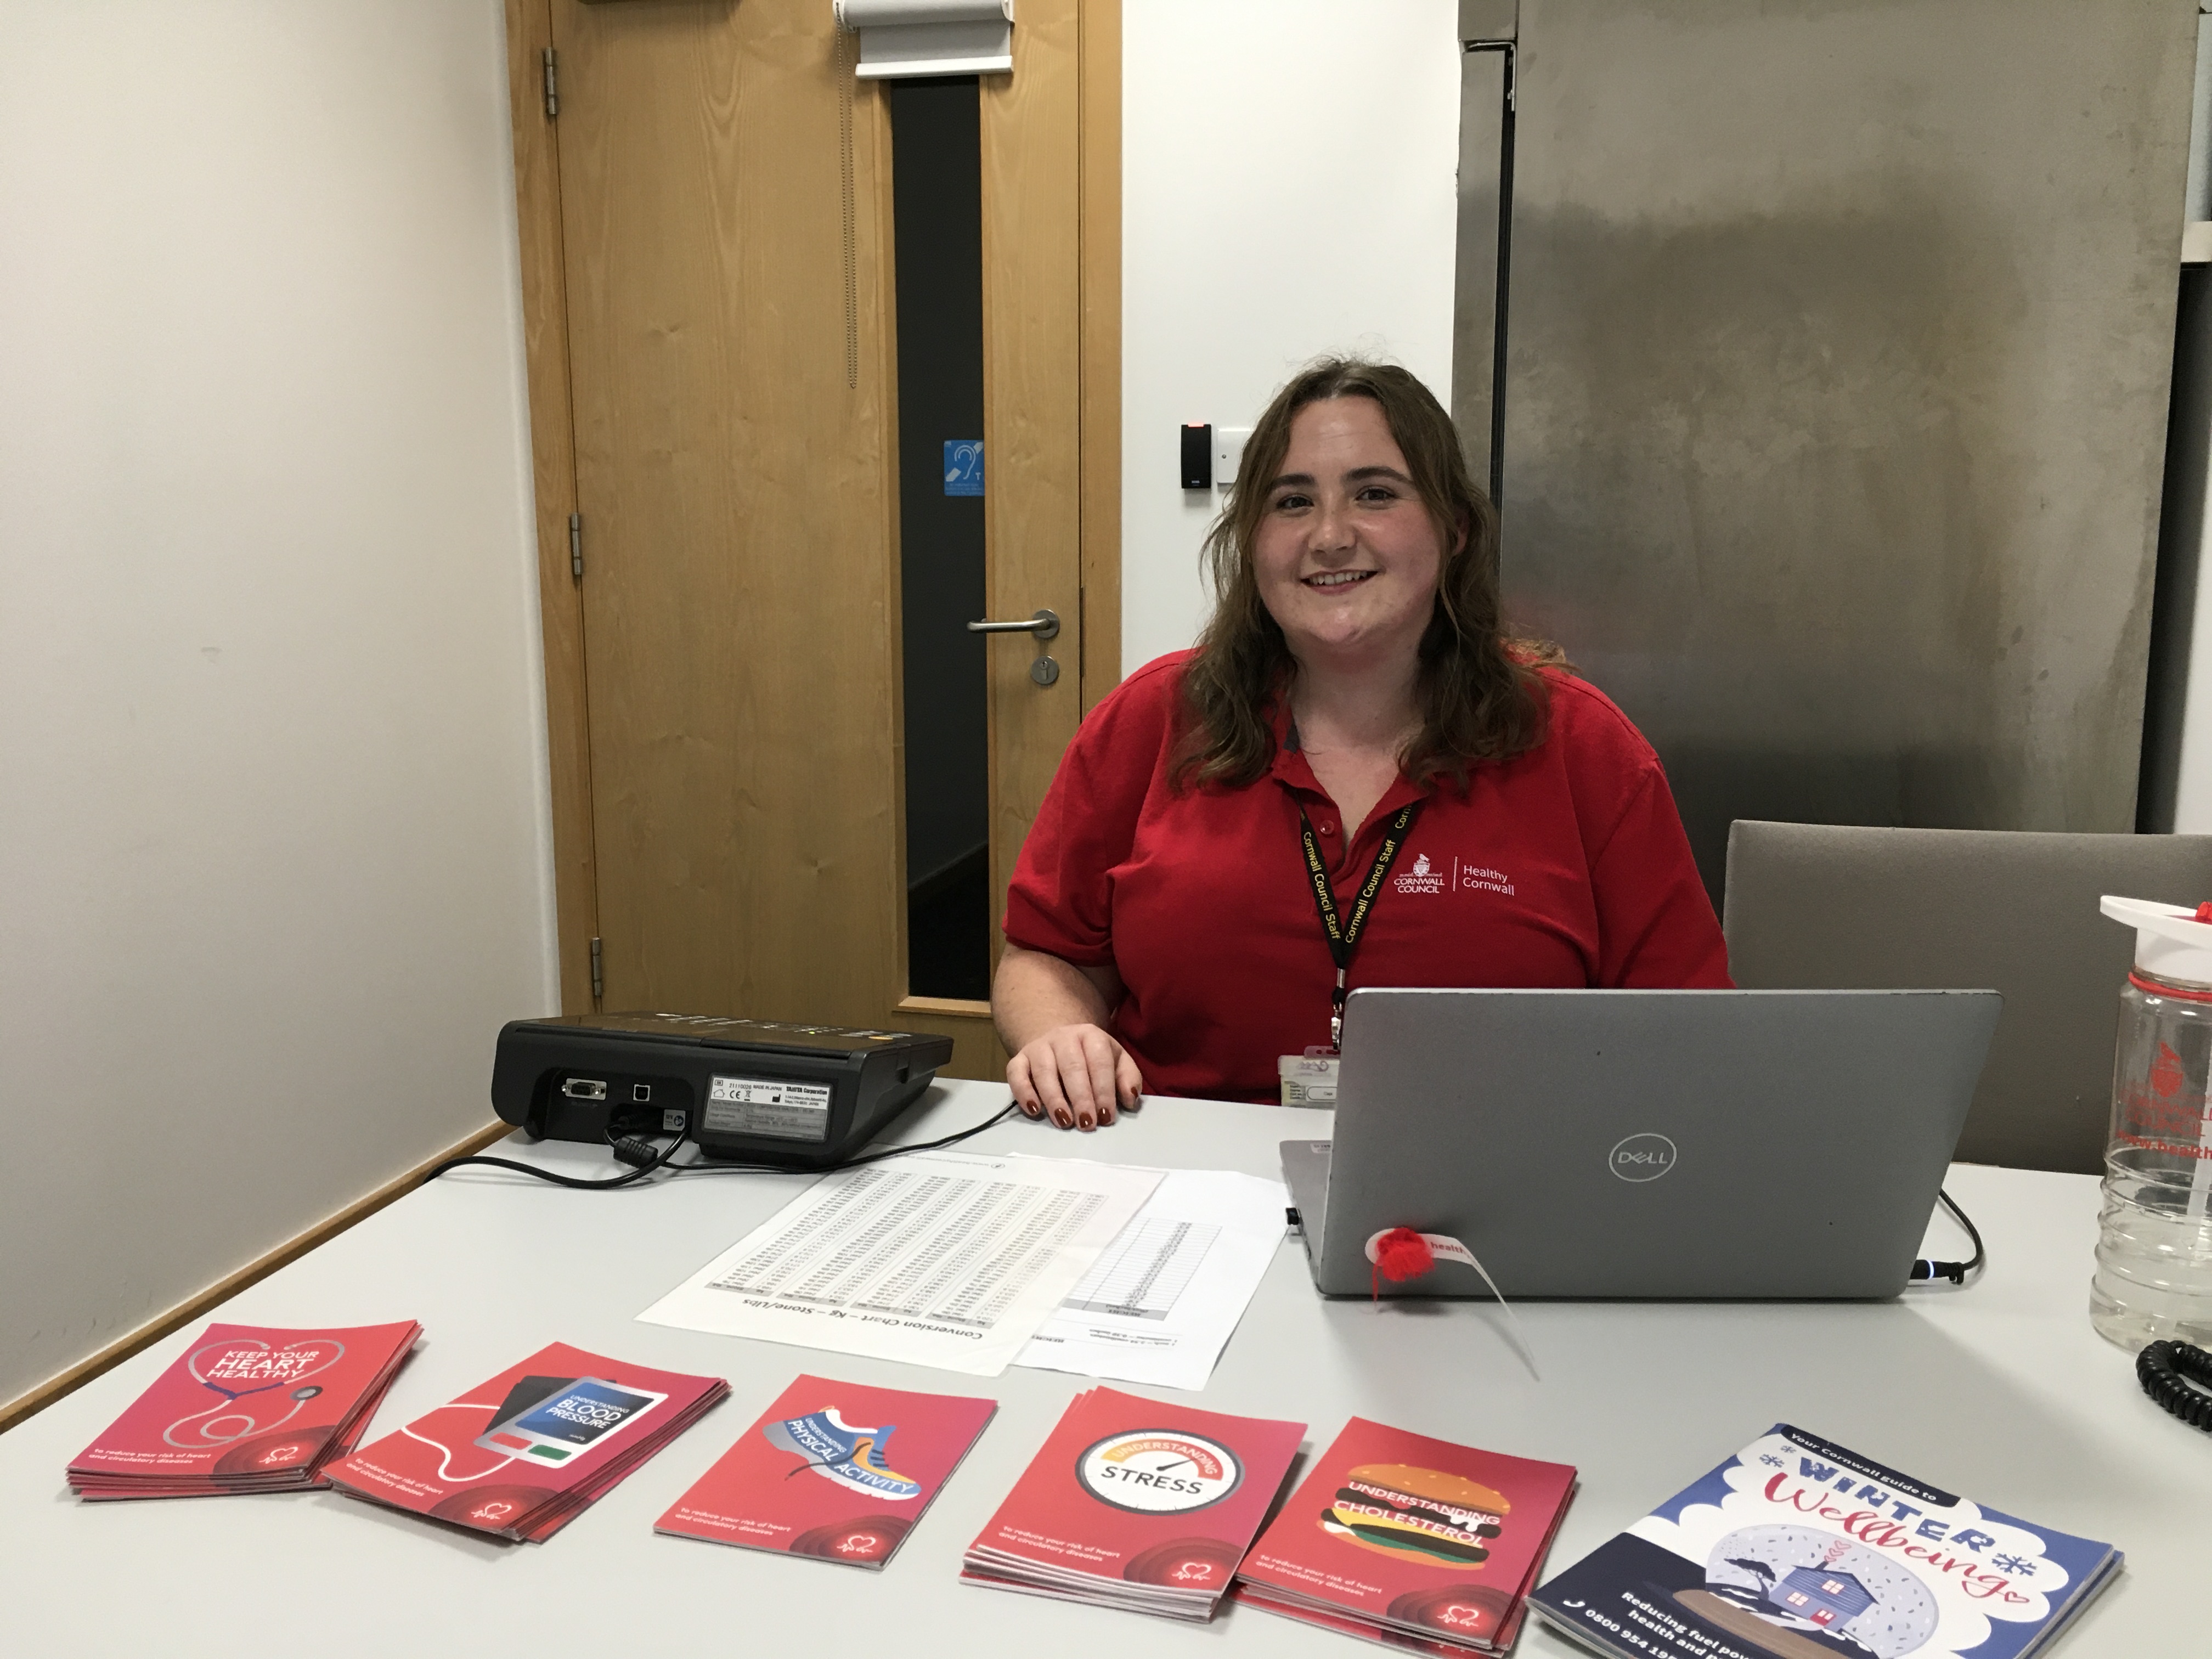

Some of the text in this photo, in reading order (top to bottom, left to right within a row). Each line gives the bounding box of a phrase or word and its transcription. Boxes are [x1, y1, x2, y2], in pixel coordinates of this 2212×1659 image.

[1304, 832, 1341, 940] Cornwall Council Staff
[1345, 804, 1413, 943] Cornwall Council Staff Corn
[1393, 878, 1445, 886] CORNWALL
[1463, 877, 1515, 896] Cornwall
[1464, 865, 1508, 884] Healthy
[1397, 885, 1440, 894] COUNCIL
[1617, 1152, 1668, 1164] DELL
[828, 1310, 847, 1318] Kg
[861, 1315, 900, 1326] Chart
[904, 1321, 983, 1340] Conversion
[206, 1369, 304, 1378] HEALTHY
[215, 1358, 315, 1370] HEART
[545, 1407, 611, 1429] PRESSURE
[556, 1398, 622, 1421] BLOOD
[570, 1395, 630, 1414] UNDERSTANDING
[788, 1420, 839, 1461] PHYSICAL
[805, 1418, 847, 1453] UNDERSTANDING
[1111, 1442, 1218, 1475] UNDERSTANDING
[1791, 1433, 1937, 1501] Your Cornwall guide to
[346, 1463, 425, 1497] and circulatory diseases
[363, 1463, 387, 1474] reduce
[423, 1485, 443, 1495] heart
[834, 1464, 915, 1493] ACTIVITY
[1101, 1466, 1204, 1494] STRESS
[1348, 1481, 1500, 1525] UNDERSTANDING
[1799, 1457, 1996, 1553] WINTER
[691, 1510, 720, 1519] reduce
[768, 1523, 791, 1532] heart
[692, 1518, 738, 1531] circulatory
[738, 1526, 774, 1536] diseases
[1334, 1500, 1483, 1549] CHOLESTEROL
[1764, 1472, 2010, 1598] Wellbeing
[998, 1532, 1103, 1561] and circulatory diseases
[1014, 1530, 1044, 1541] reduce
[1096, 1548, 1120, 1558] heart
[1255, 1561, 1364, 1596] and circulatory diseases
[1272, 1558, 1303, 1571] reduce
[1304, 1568, 1325, 1577] your
[1325, 1574, 1343, 1583] risk
[1356, 1582, 1382, 1594] heart
[1585, 1609, 1621, 1632] 0800
[1620, 1629, 1649, 1649] 954
[1621, 1592, 1688, 1634] Reducing
[1688, 1629, 1720, 1649] fuel
[1628, 1610, 1707, 1656] health and
